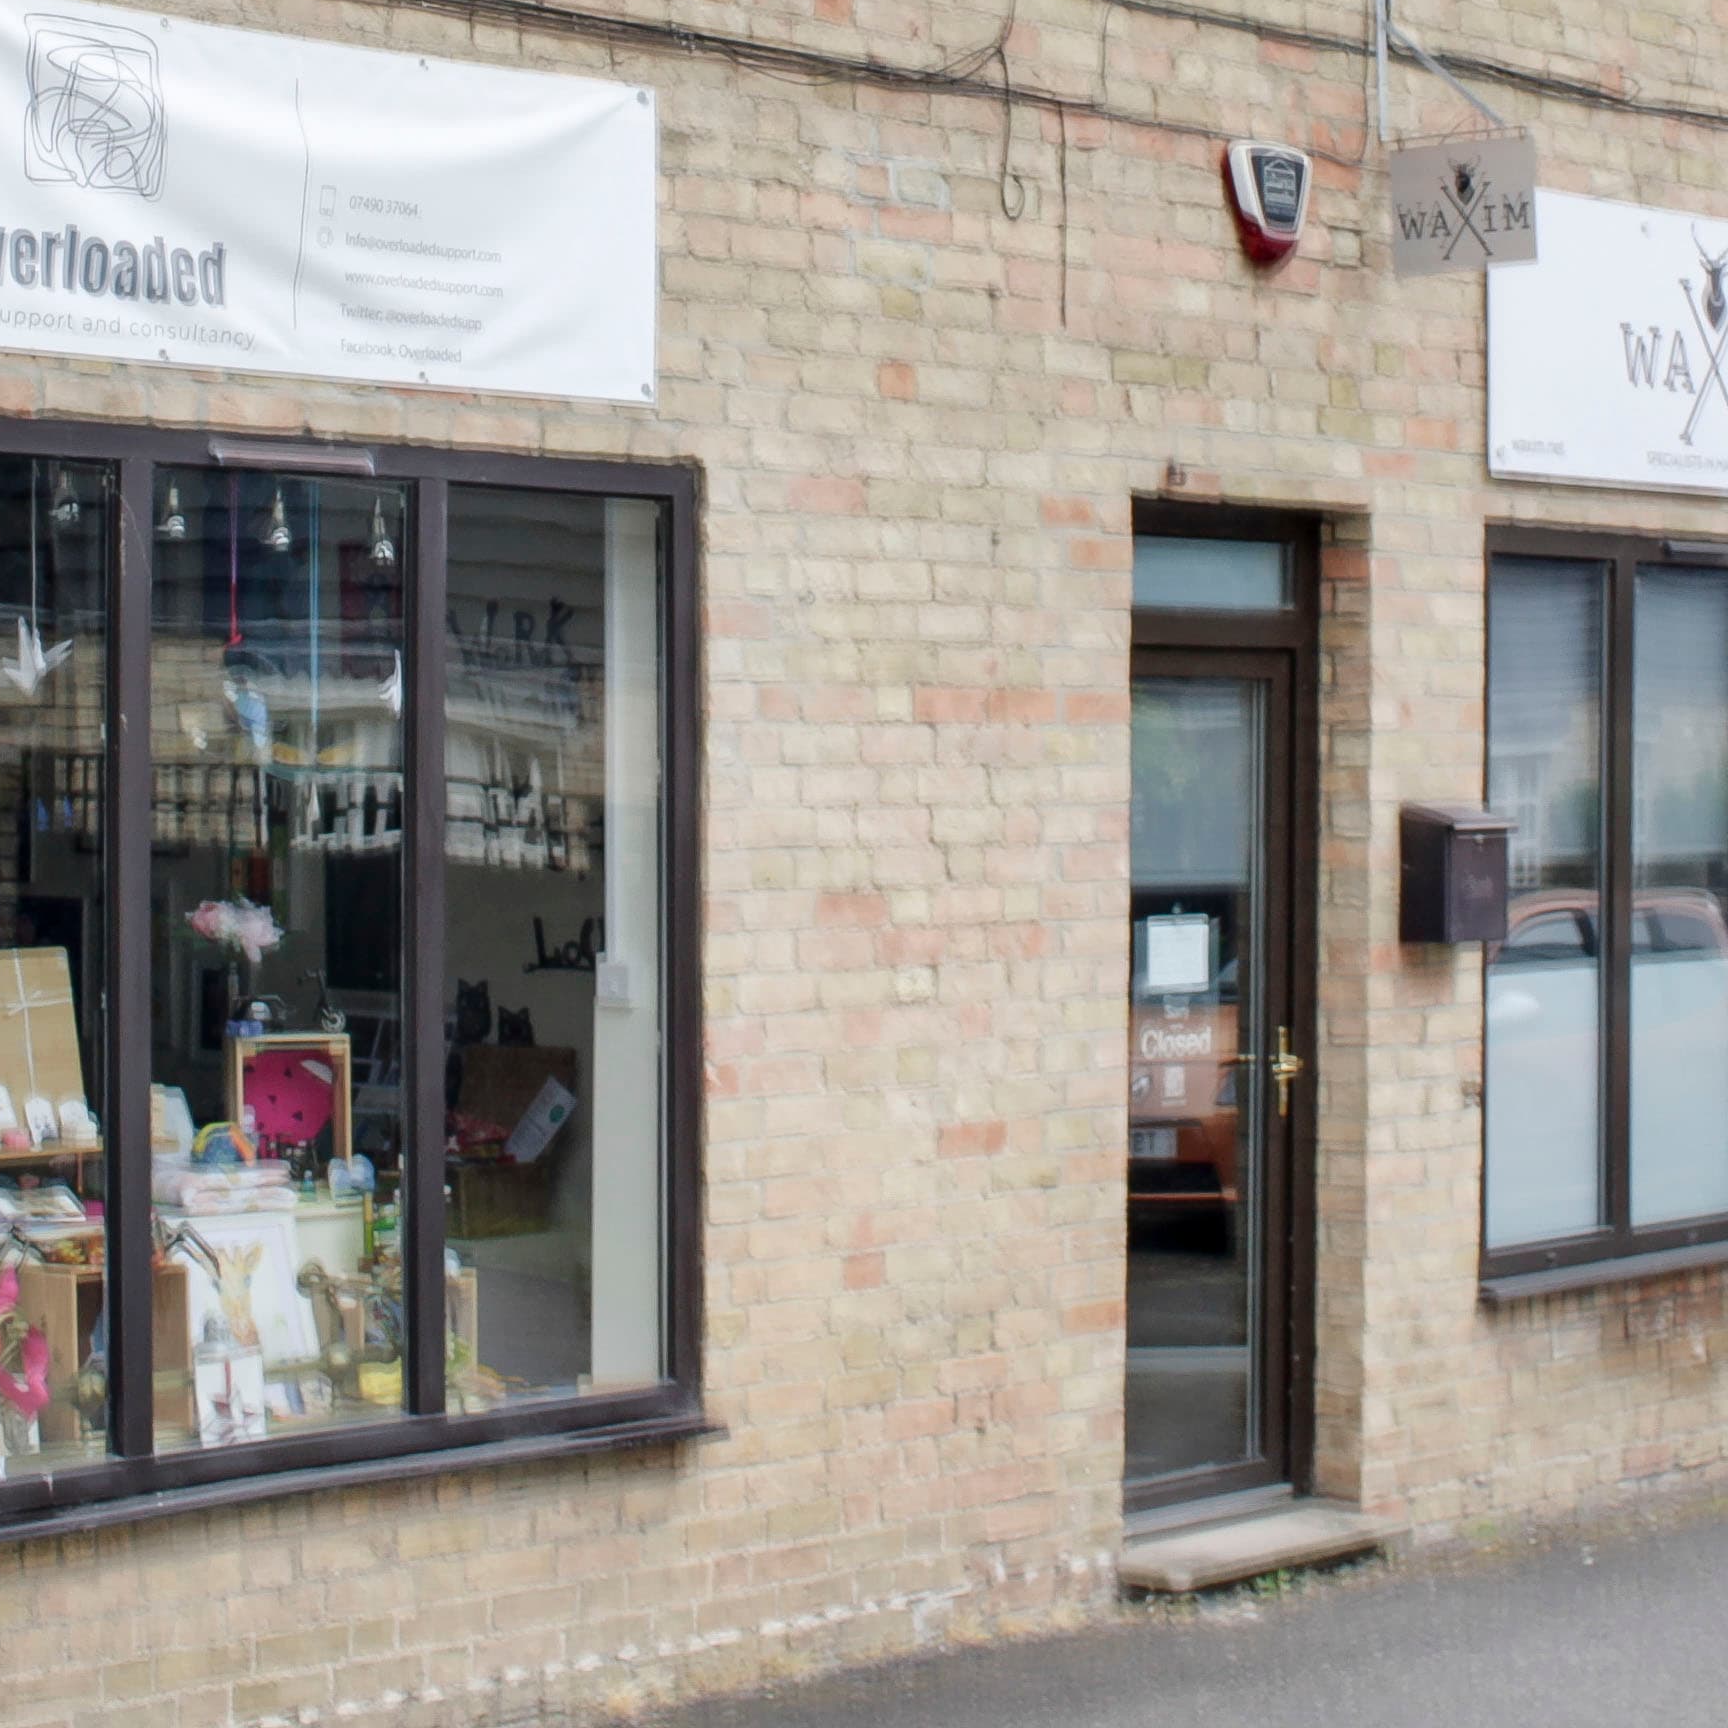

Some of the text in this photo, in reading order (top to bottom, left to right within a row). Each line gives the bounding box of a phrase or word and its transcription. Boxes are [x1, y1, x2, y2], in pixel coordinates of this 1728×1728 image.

[1397, 175, 1530, 260] WAXIM
[82, 315, 122, 335] and
[130, 322, 256, 351] consultancy
[398, 343, 462, 364] Overloaded
[1141, 1026, 1212, 1060] Closed
